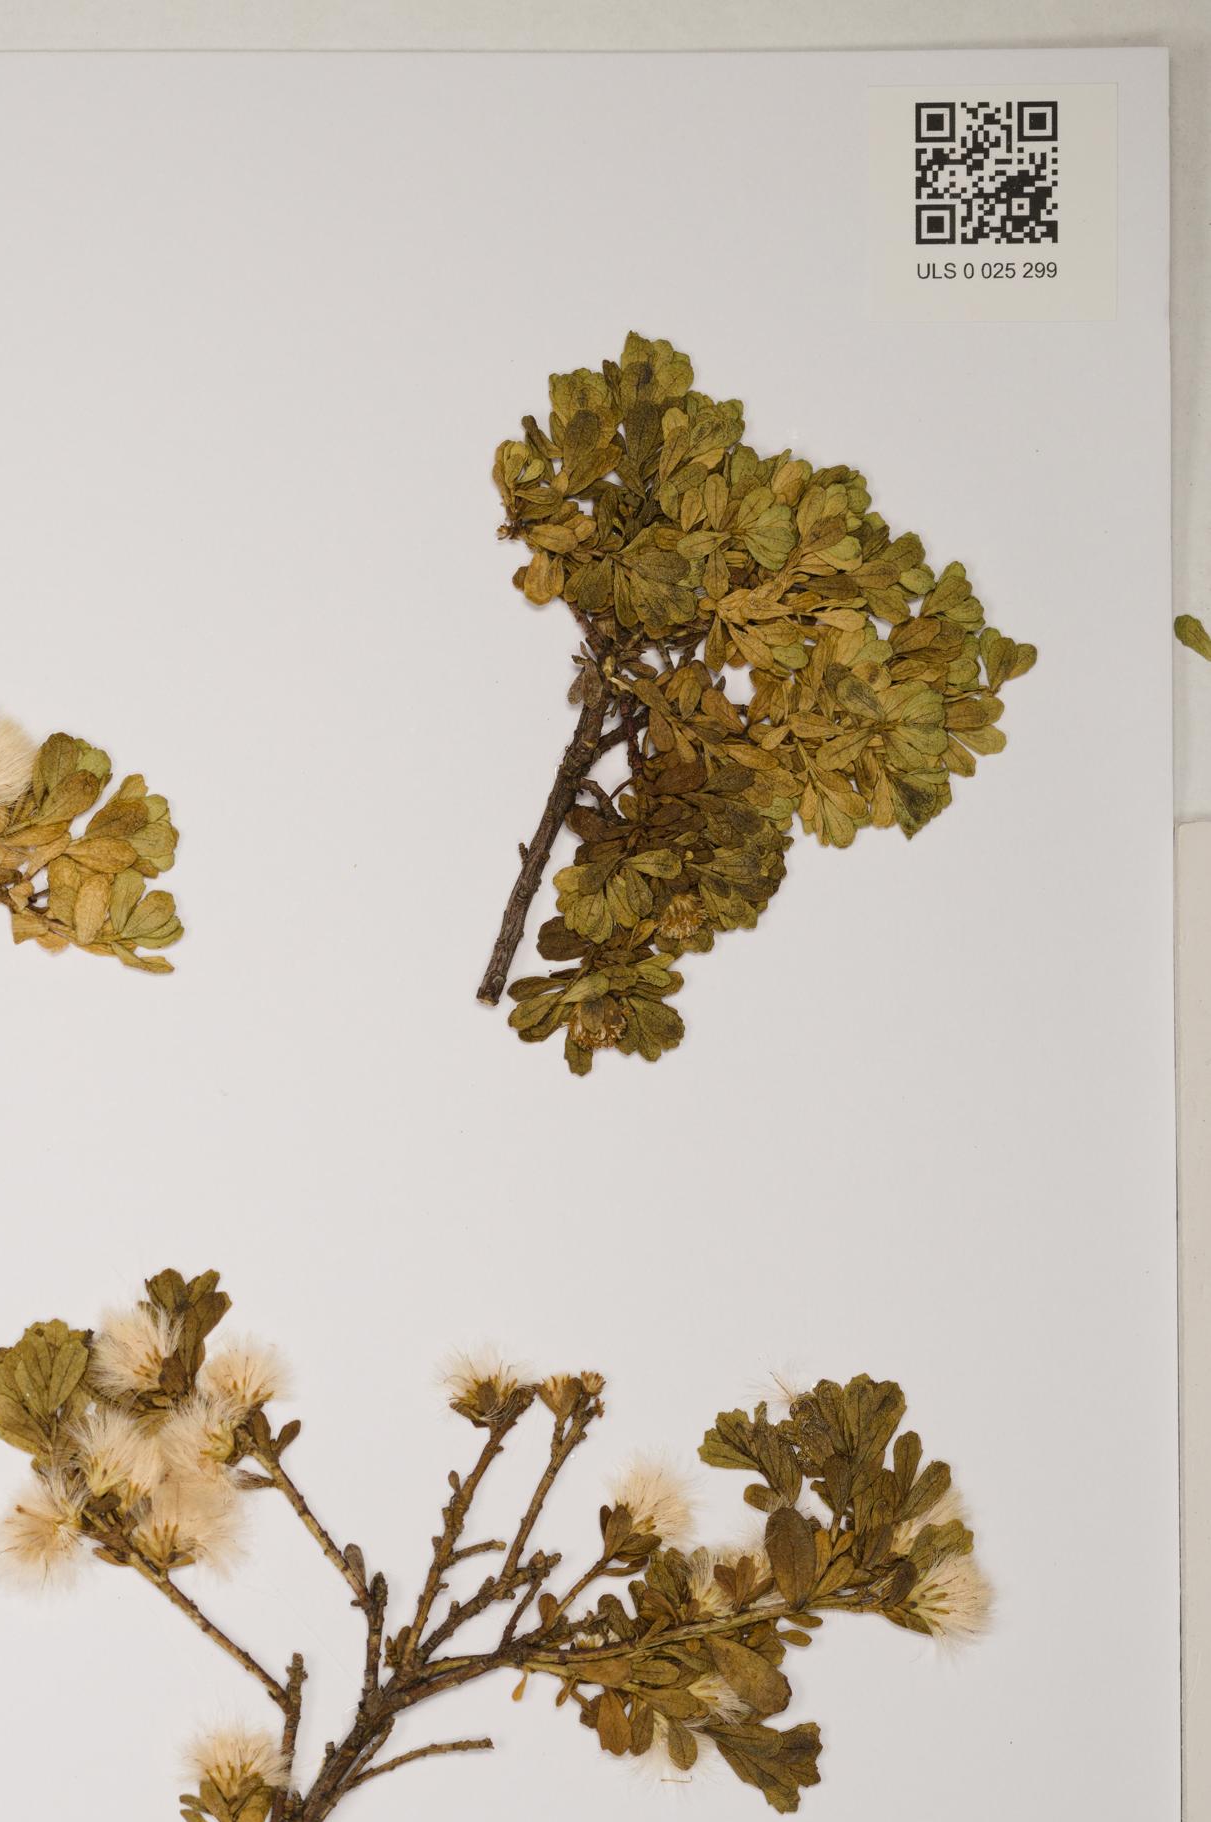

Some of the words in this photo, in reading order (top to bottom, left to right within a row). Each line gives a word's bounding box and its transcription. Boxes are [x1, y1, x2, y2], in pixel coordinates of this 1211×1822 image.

[917, 262, 957, 280] ULS
[963, 262, 975, 280] 0
[980, 262, 1017, 280] 025
[1022, 261, 1058, 279] 299
